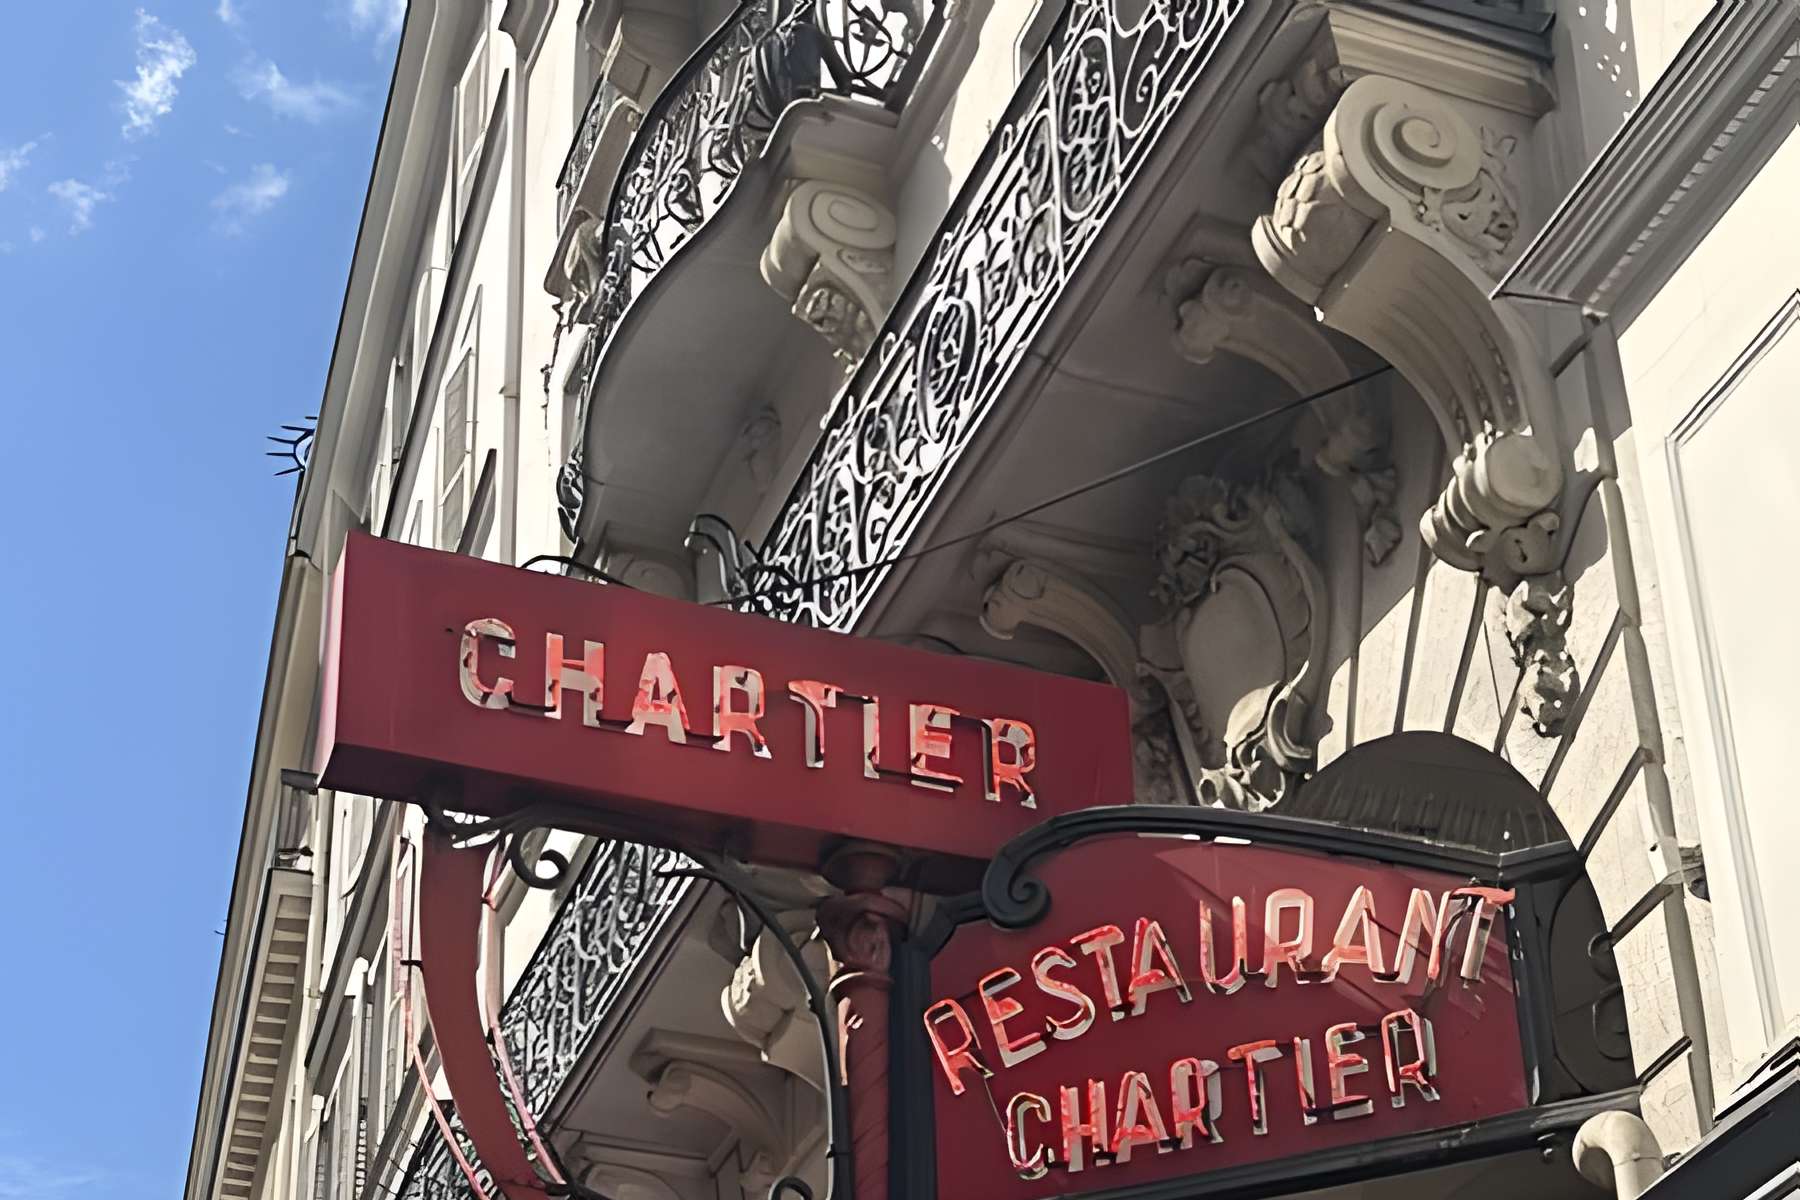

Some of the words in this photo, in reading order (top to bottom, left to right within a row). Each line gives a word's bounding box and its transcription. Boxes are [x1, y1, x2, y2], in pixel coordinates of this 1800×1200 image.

[458, 616, 1038, 810] CHARTIER
[923, 882, 1515, 1096] RESTAURANT
[1005, 1008, 1441, 1180] CHARTIER
